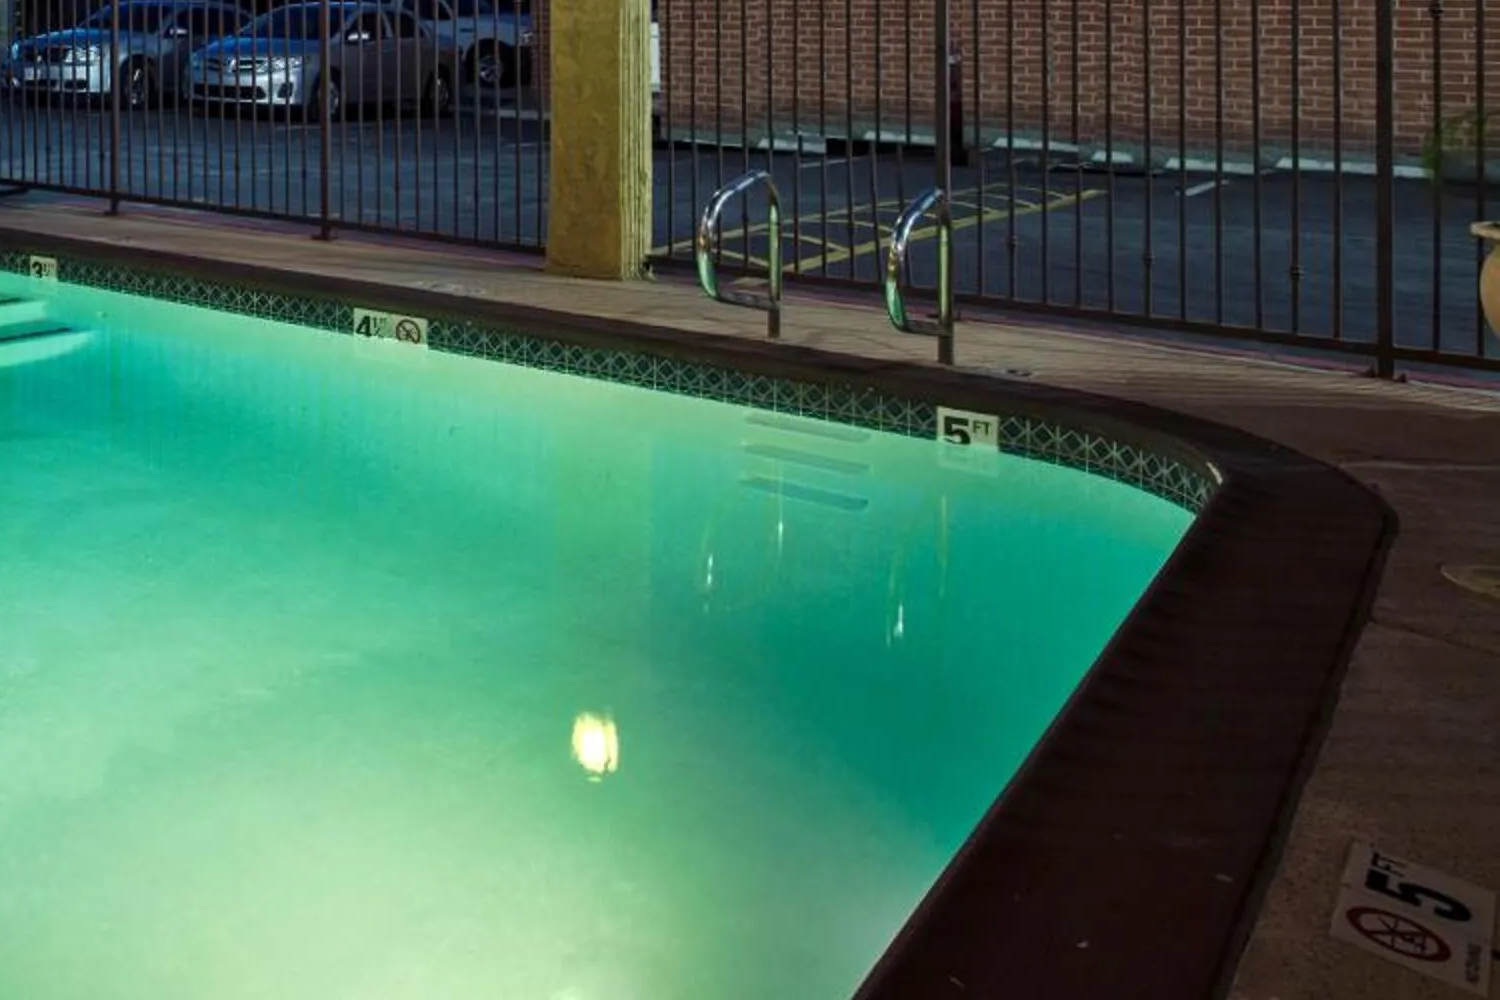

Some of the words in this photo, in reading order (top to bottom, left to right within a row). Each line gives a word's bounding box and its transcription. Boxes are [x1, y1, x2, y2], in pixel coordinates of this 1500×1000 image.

[944, 416, 970, 445] 5
[973, 421, 990, 436] FT
[1371, 850, 1409, 878] FT
[1365, 868, 1473, 922] 5
